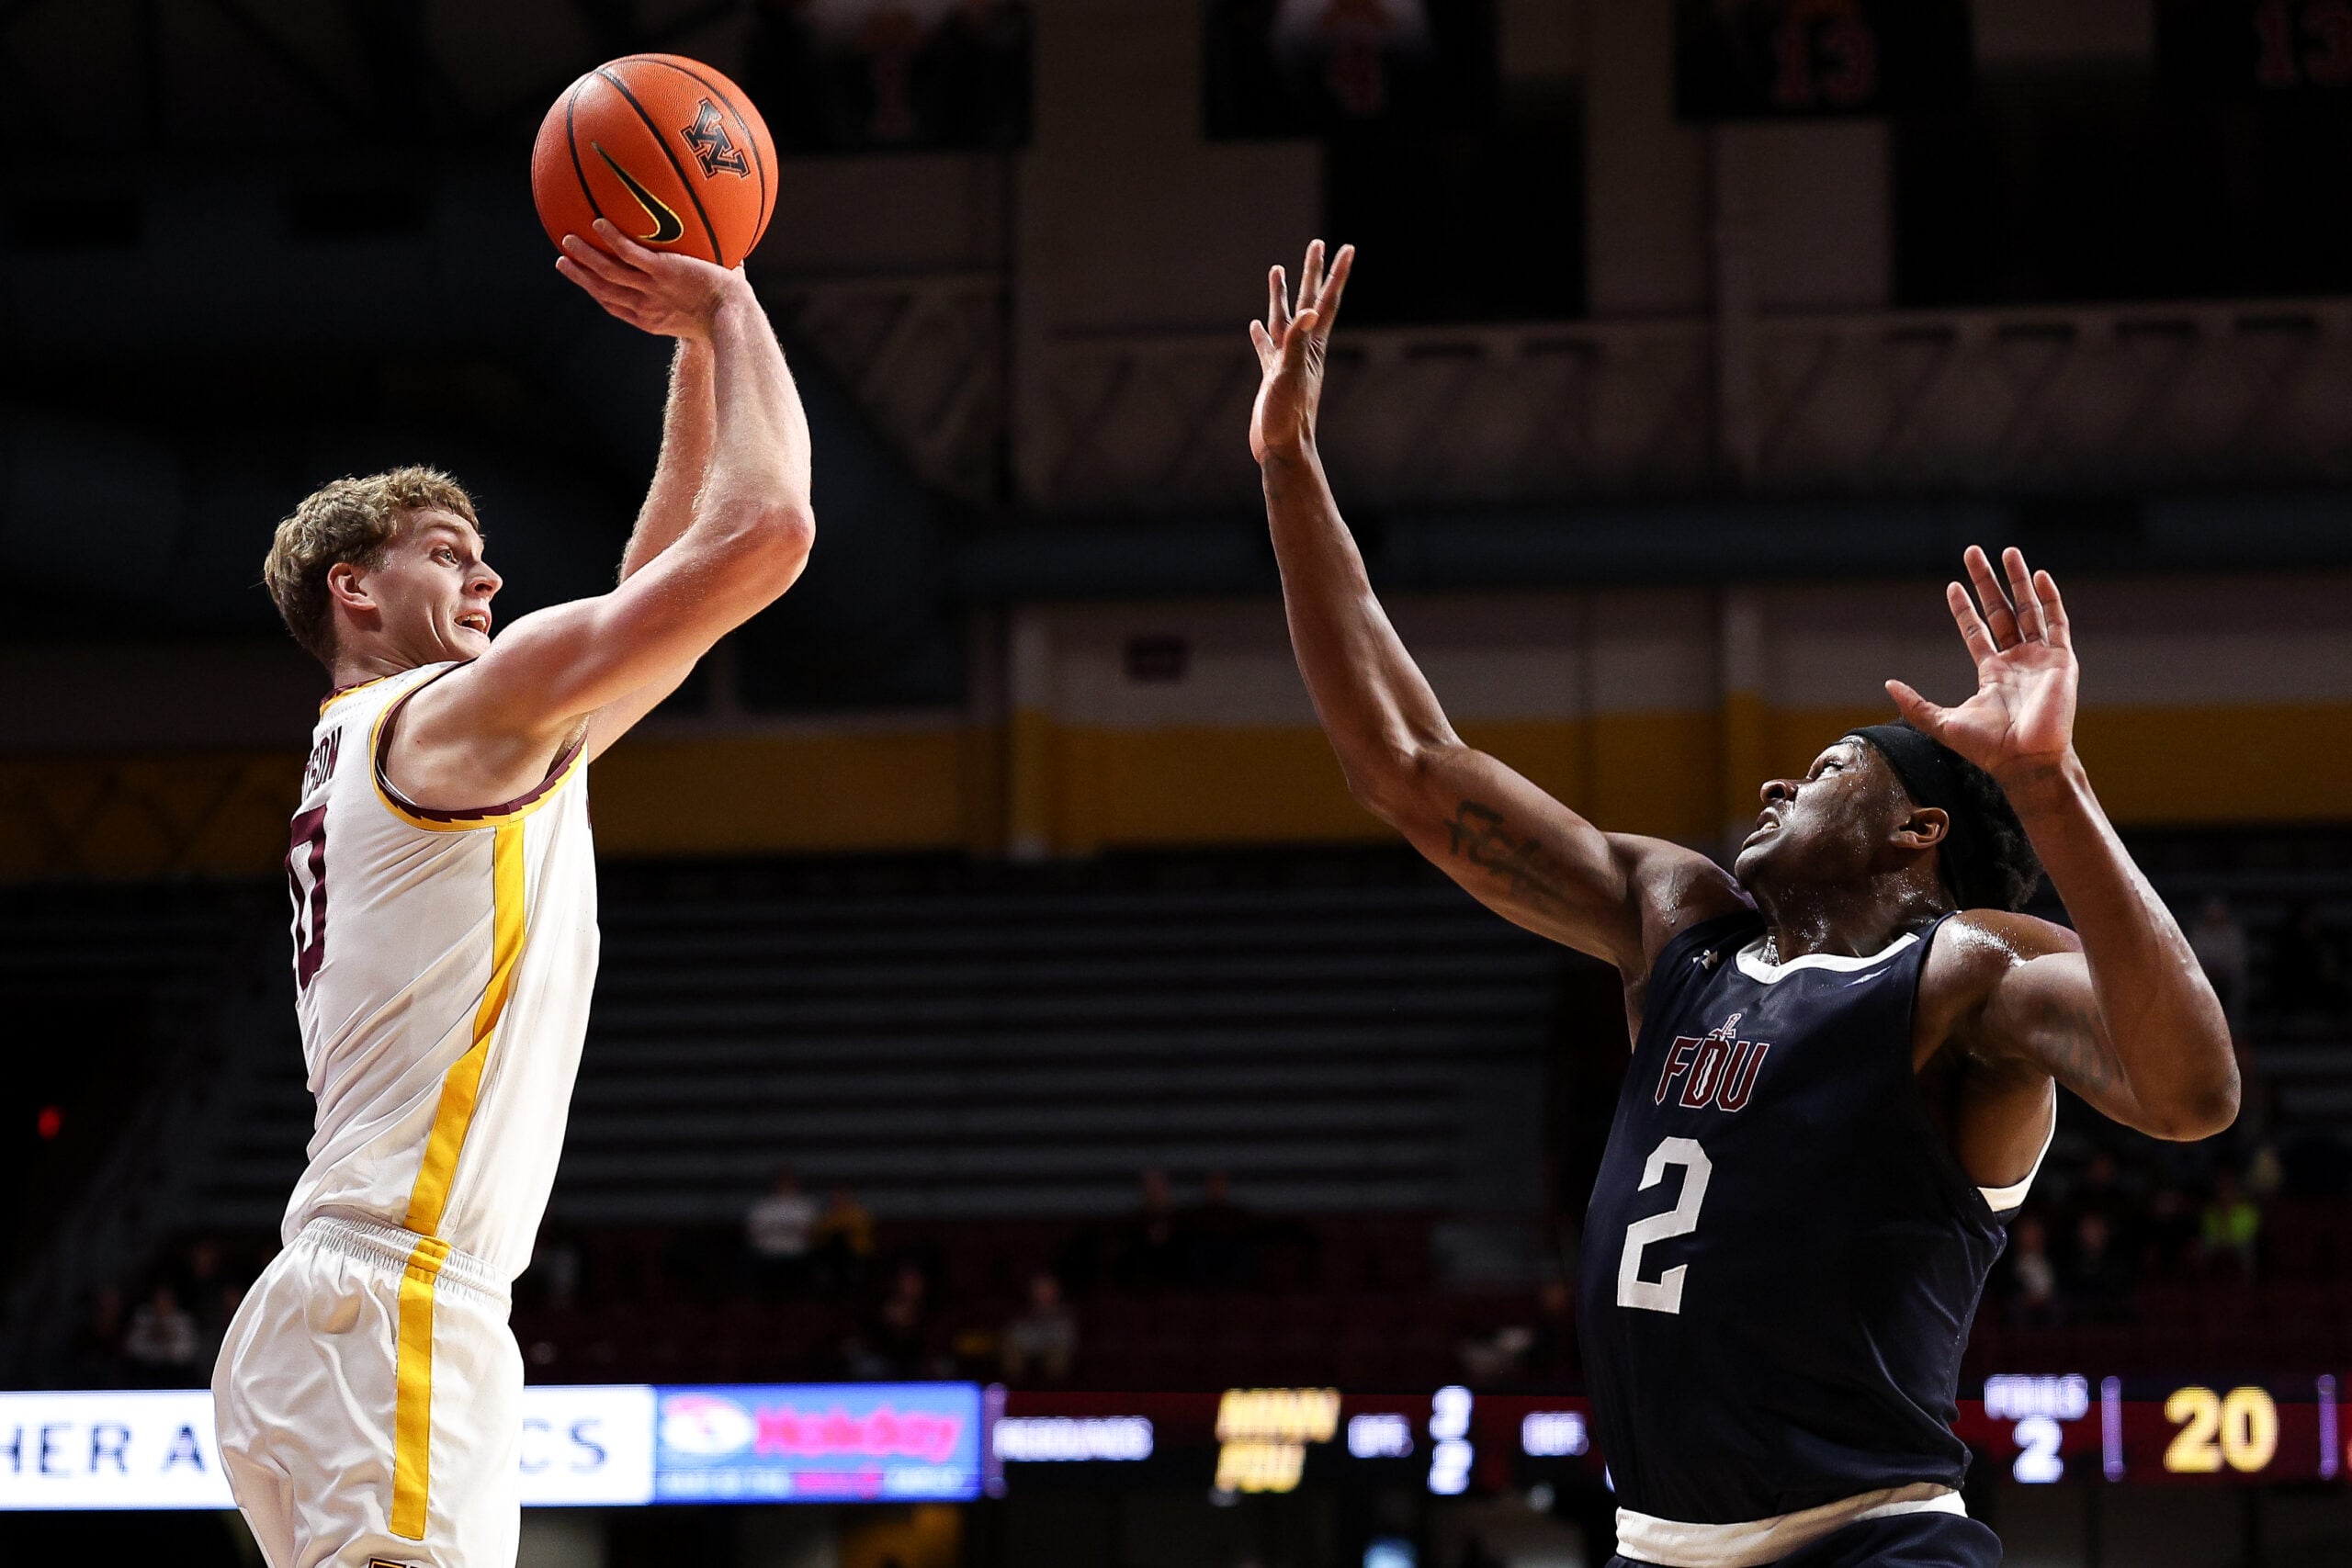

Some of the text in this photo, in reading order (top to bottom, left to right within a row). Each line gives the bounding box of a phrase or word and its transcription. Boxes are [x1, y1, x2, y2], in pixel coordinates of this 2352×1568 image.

[1655, 1035, 1771, 1112] FDU
[1617, 1135, 1713, 1314] 2
[2012, 1415, 2064, 1484] 2
[2163, 1385, 2280, 1473] 20
